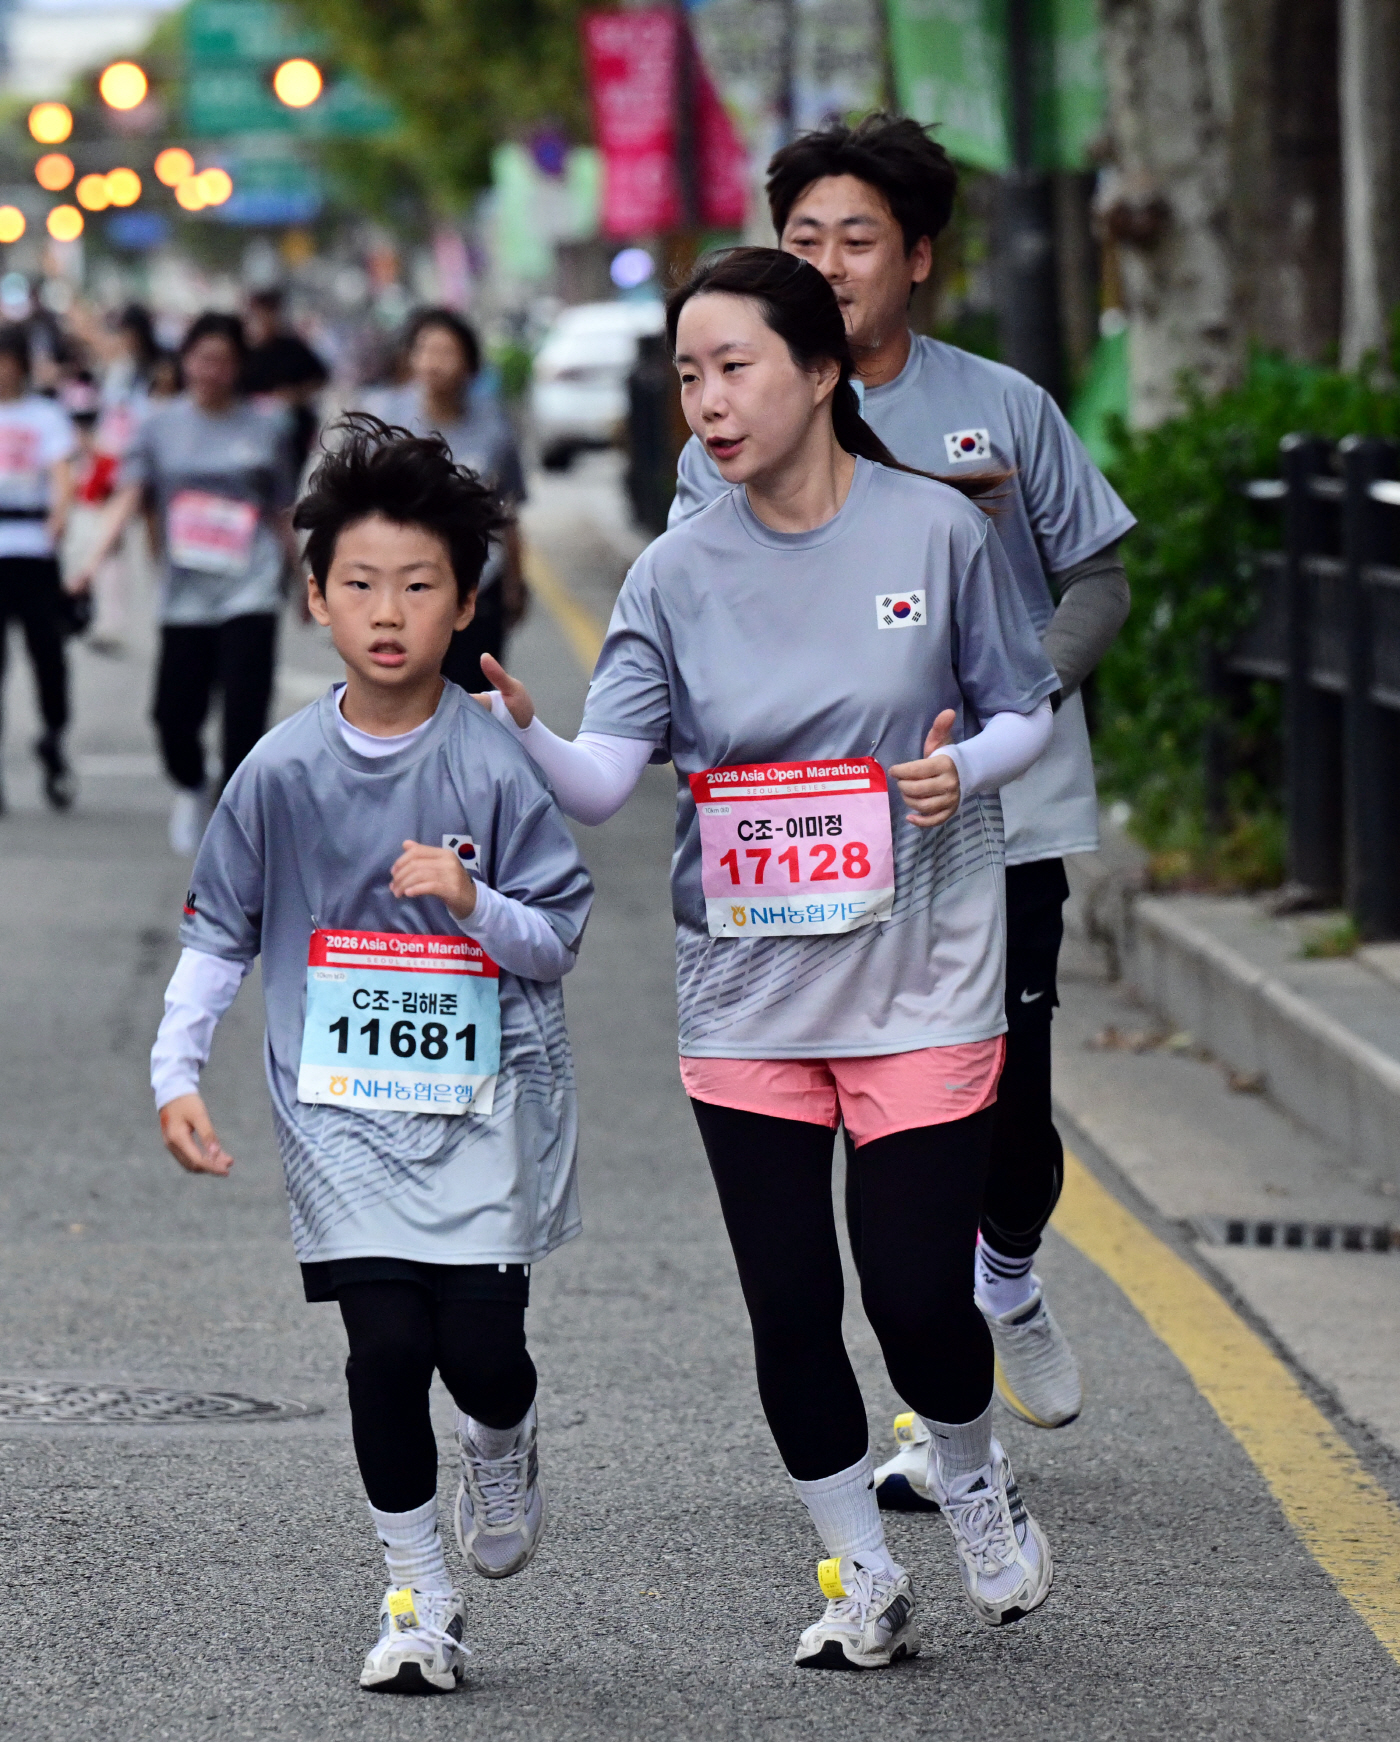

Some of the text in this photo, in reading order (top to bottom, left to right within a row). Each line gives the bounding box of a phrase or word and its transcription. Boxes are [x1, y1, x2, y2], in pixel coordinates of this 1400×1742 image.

[706, 763, 869, 783] 2026 Asia Open Marathon
[746, 784, 826, 795] SEOUL SERIES
[737, 814, 842, 841] C조-이미정
[719, 841, 871, 885] 17128
[751, 901, 866, 925] NH농협카드
[326, 935, 484, 957] 2026 Asia Open Marathon
[367, 957, 447, 968] SEOUL SERIES
[352, 988, 458, 1015] C조-김해준
[329, 1016, 477, 1062] 11681
[353, 1078, 473, 1104] NH농협은행
